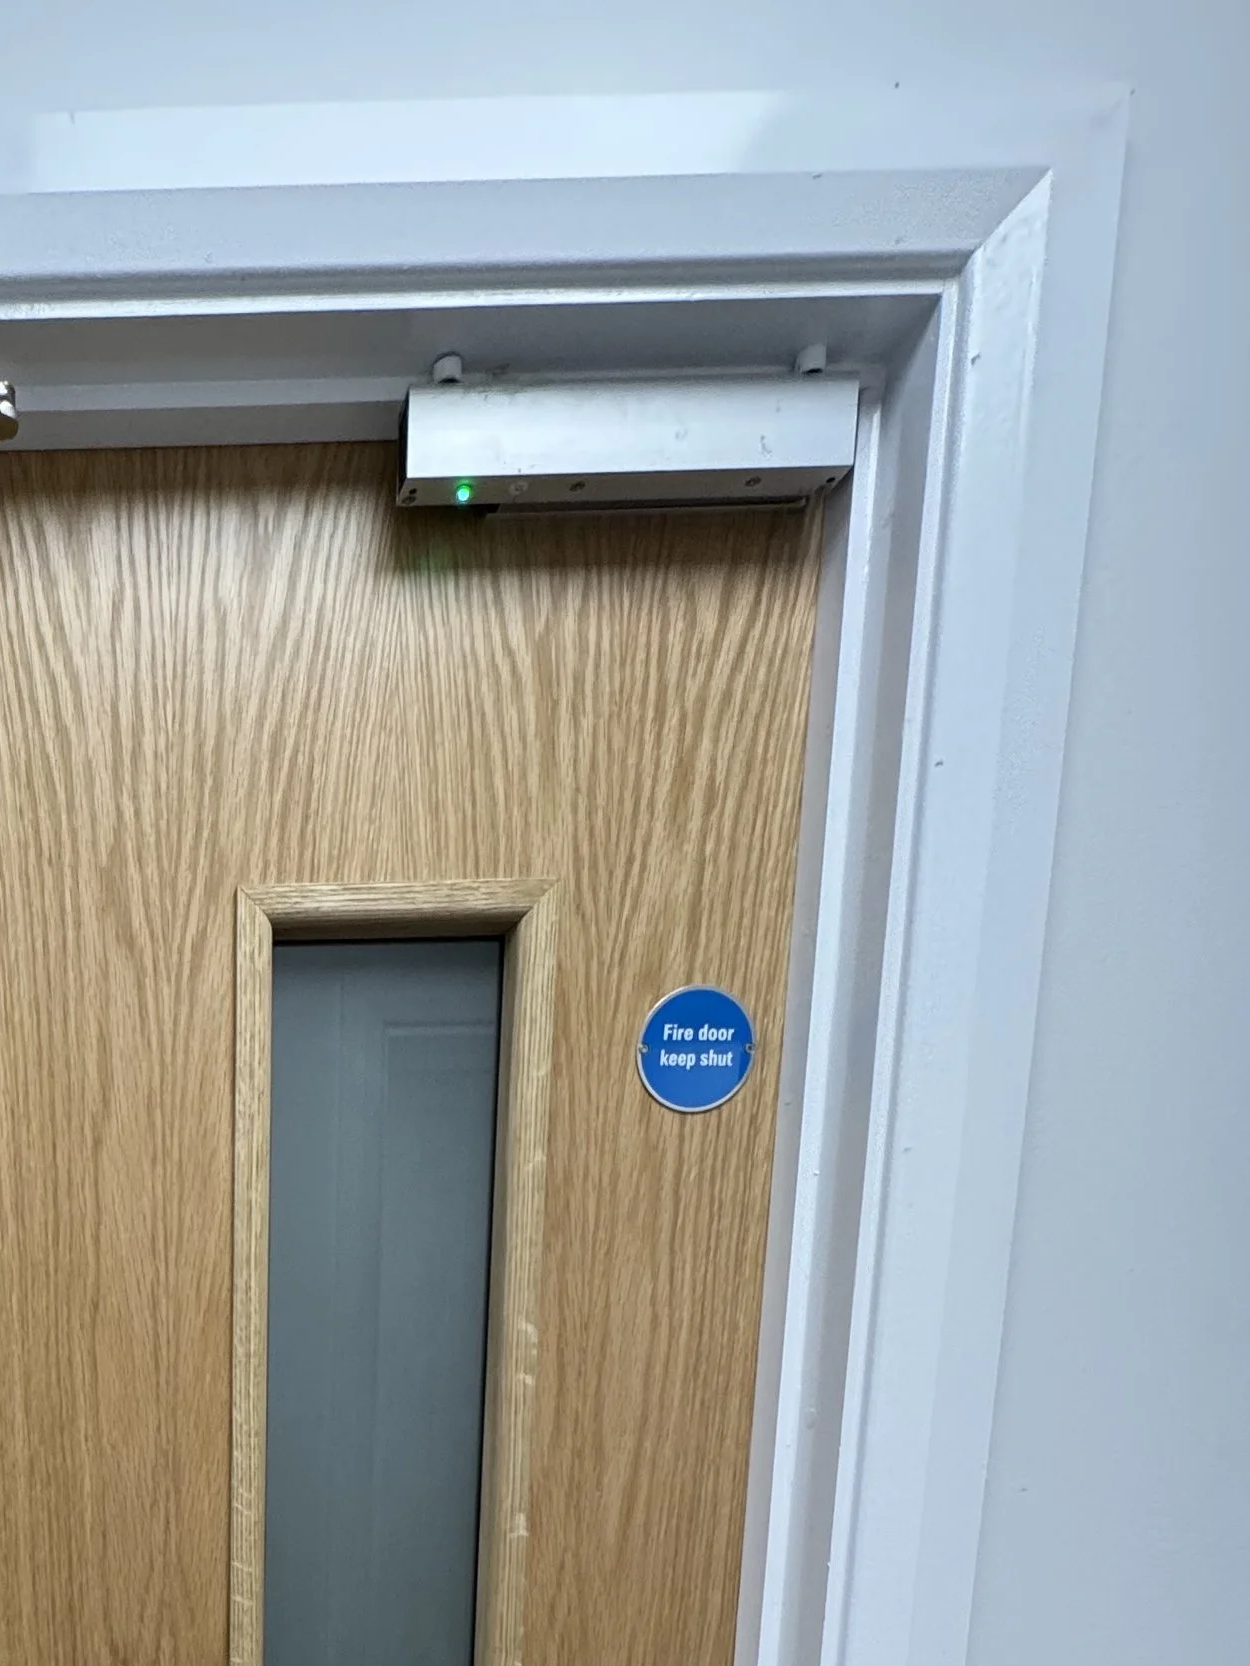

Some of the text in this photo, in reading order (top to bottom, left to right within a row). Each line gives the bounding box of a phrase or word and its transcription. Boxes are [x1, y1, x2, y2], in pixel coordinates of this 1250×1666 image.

[663, 1024, 735, 1041] Fire door
[659, 1049, 733, 1070] keep shut
